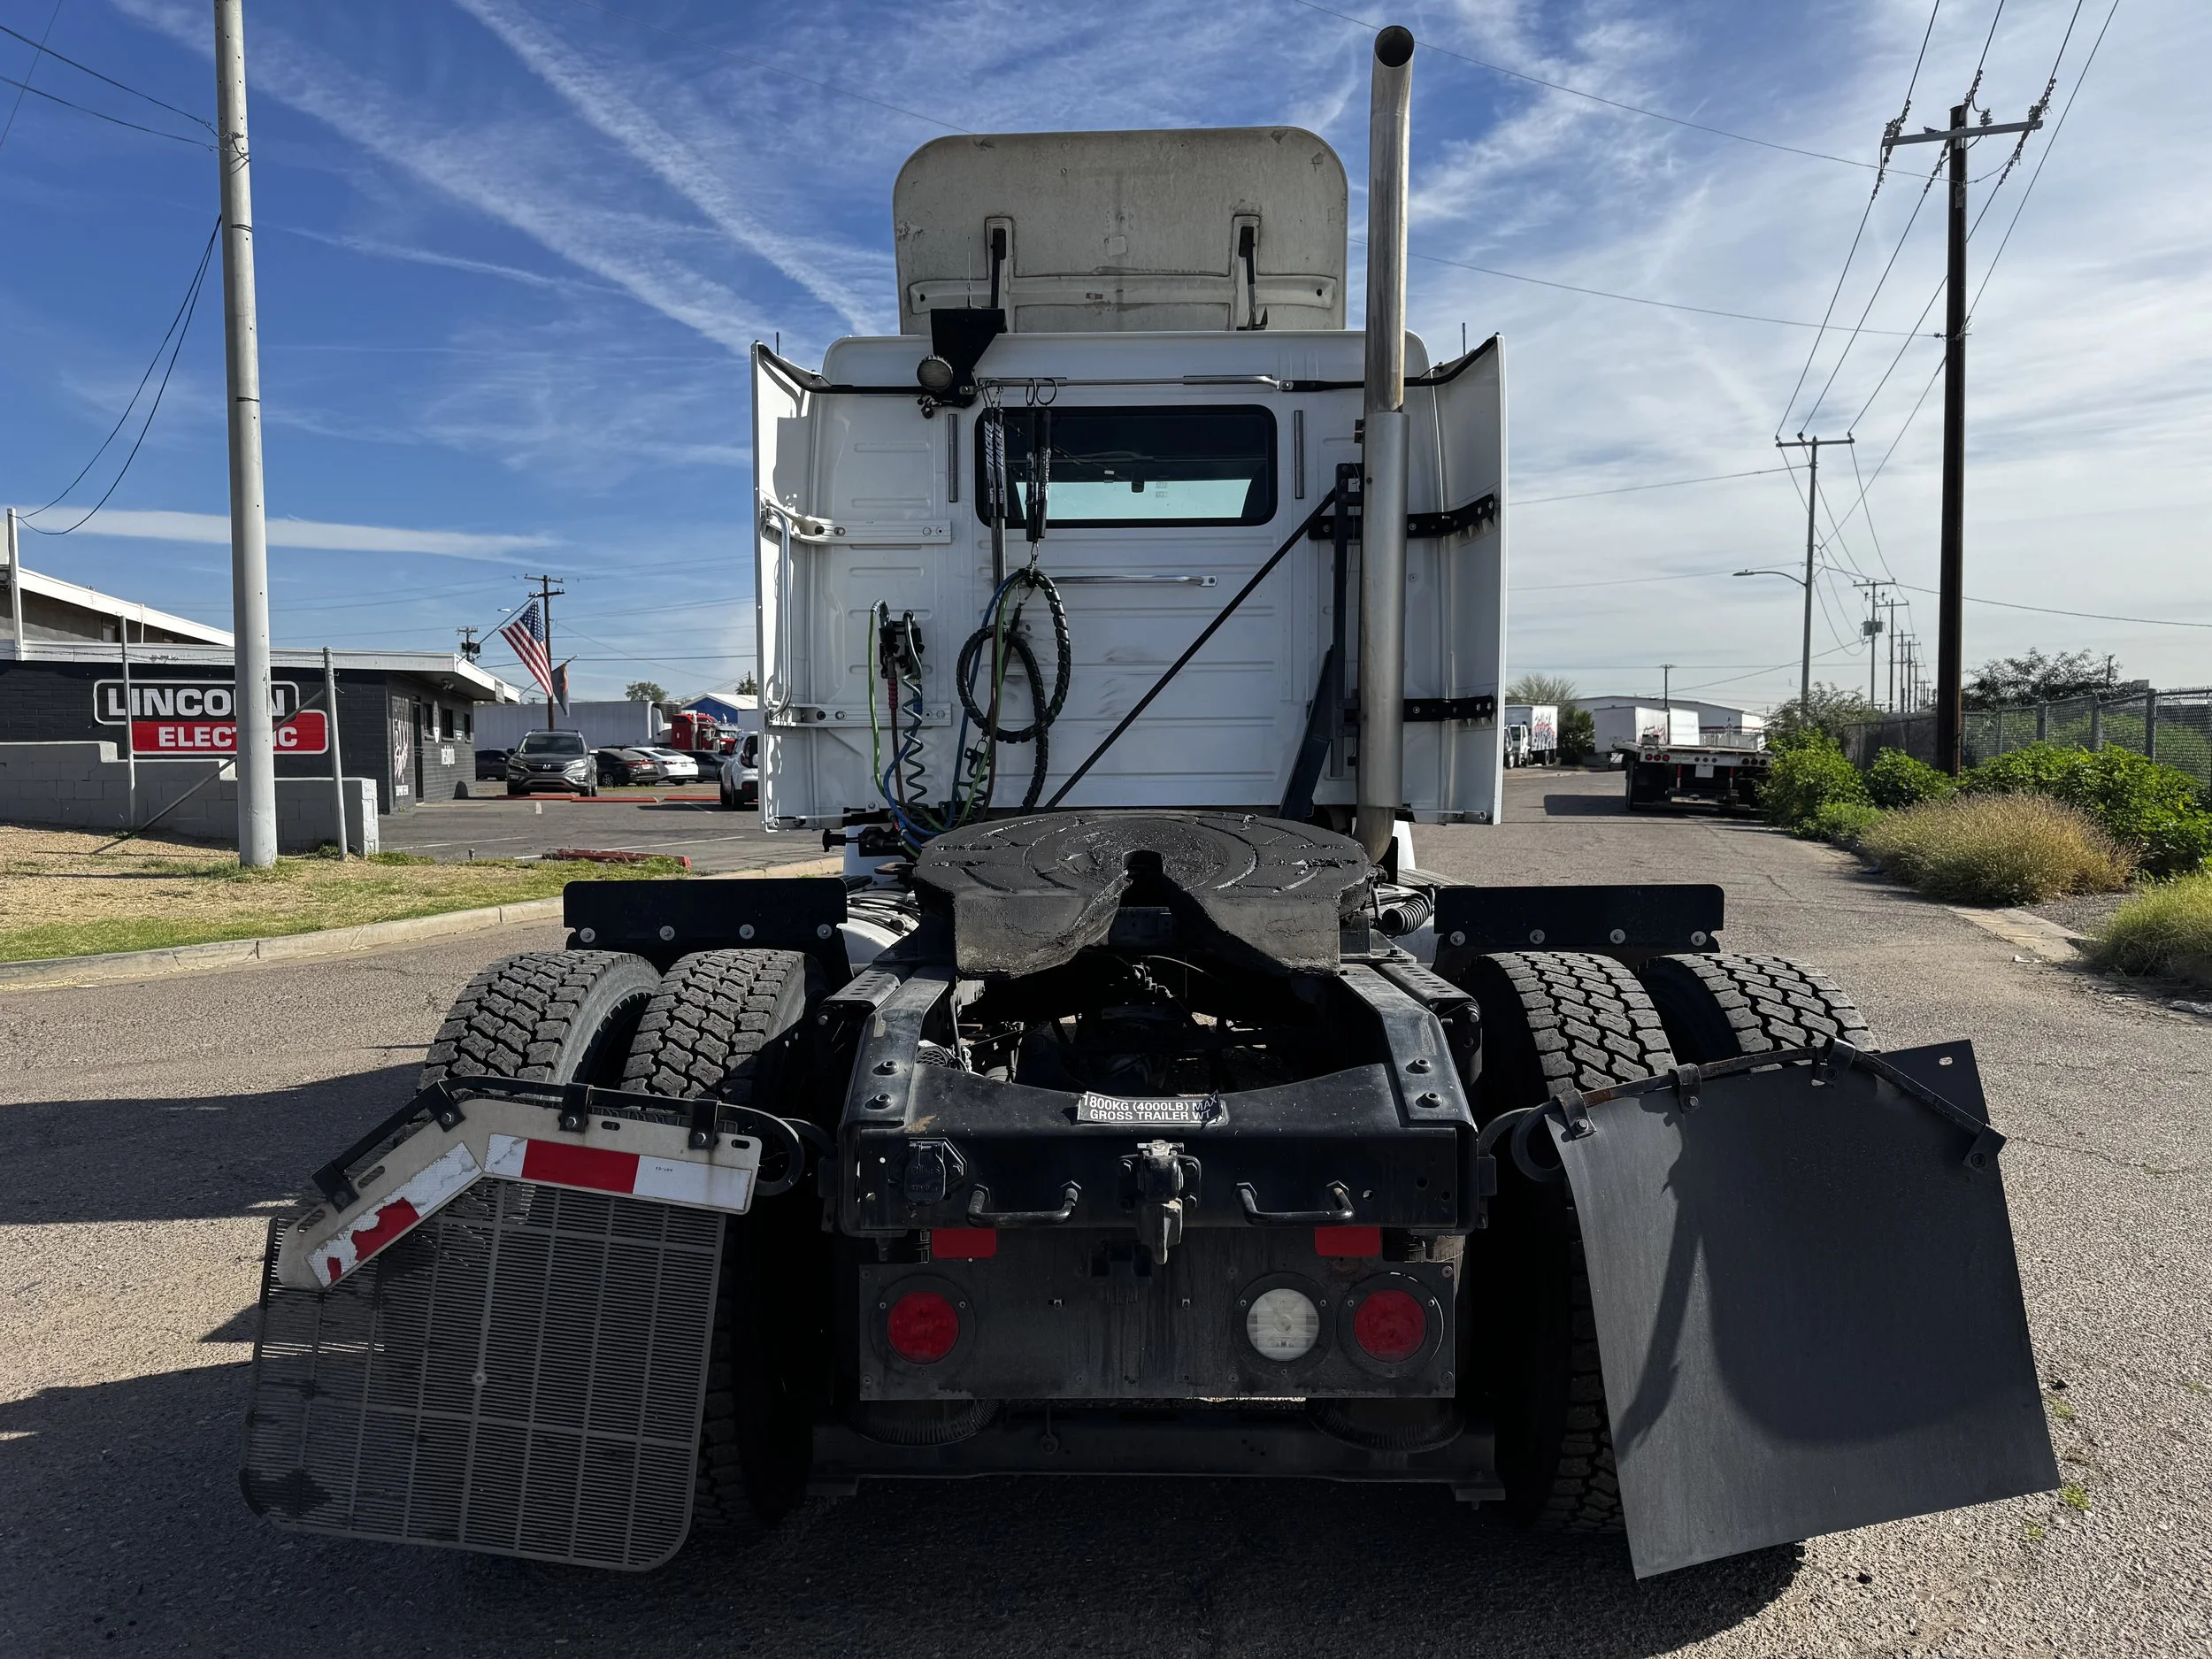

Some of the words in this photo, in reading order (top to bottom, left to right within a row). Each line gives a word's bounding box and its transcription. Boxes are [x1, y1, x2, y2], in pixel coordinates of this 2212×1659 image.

[984, 420, 994, 467] TRACKER
[995, 421, 1003, 467] TRACKER
[107, 688, 285, 717] LINCON
[158, 726, 297, 747] ELECIC
[1082, 1094, 1129, 1111] 1800KG
[1133, 1102, 1189, 1112] (4000LB)
[1192, 1094, 1217, 1111] MAX
[1089, 1109, 1133, 1120] GROSS
[1136, 1111, 1189, 1120] TRAILER
[1191, 1109, 1211, 1120] WT
